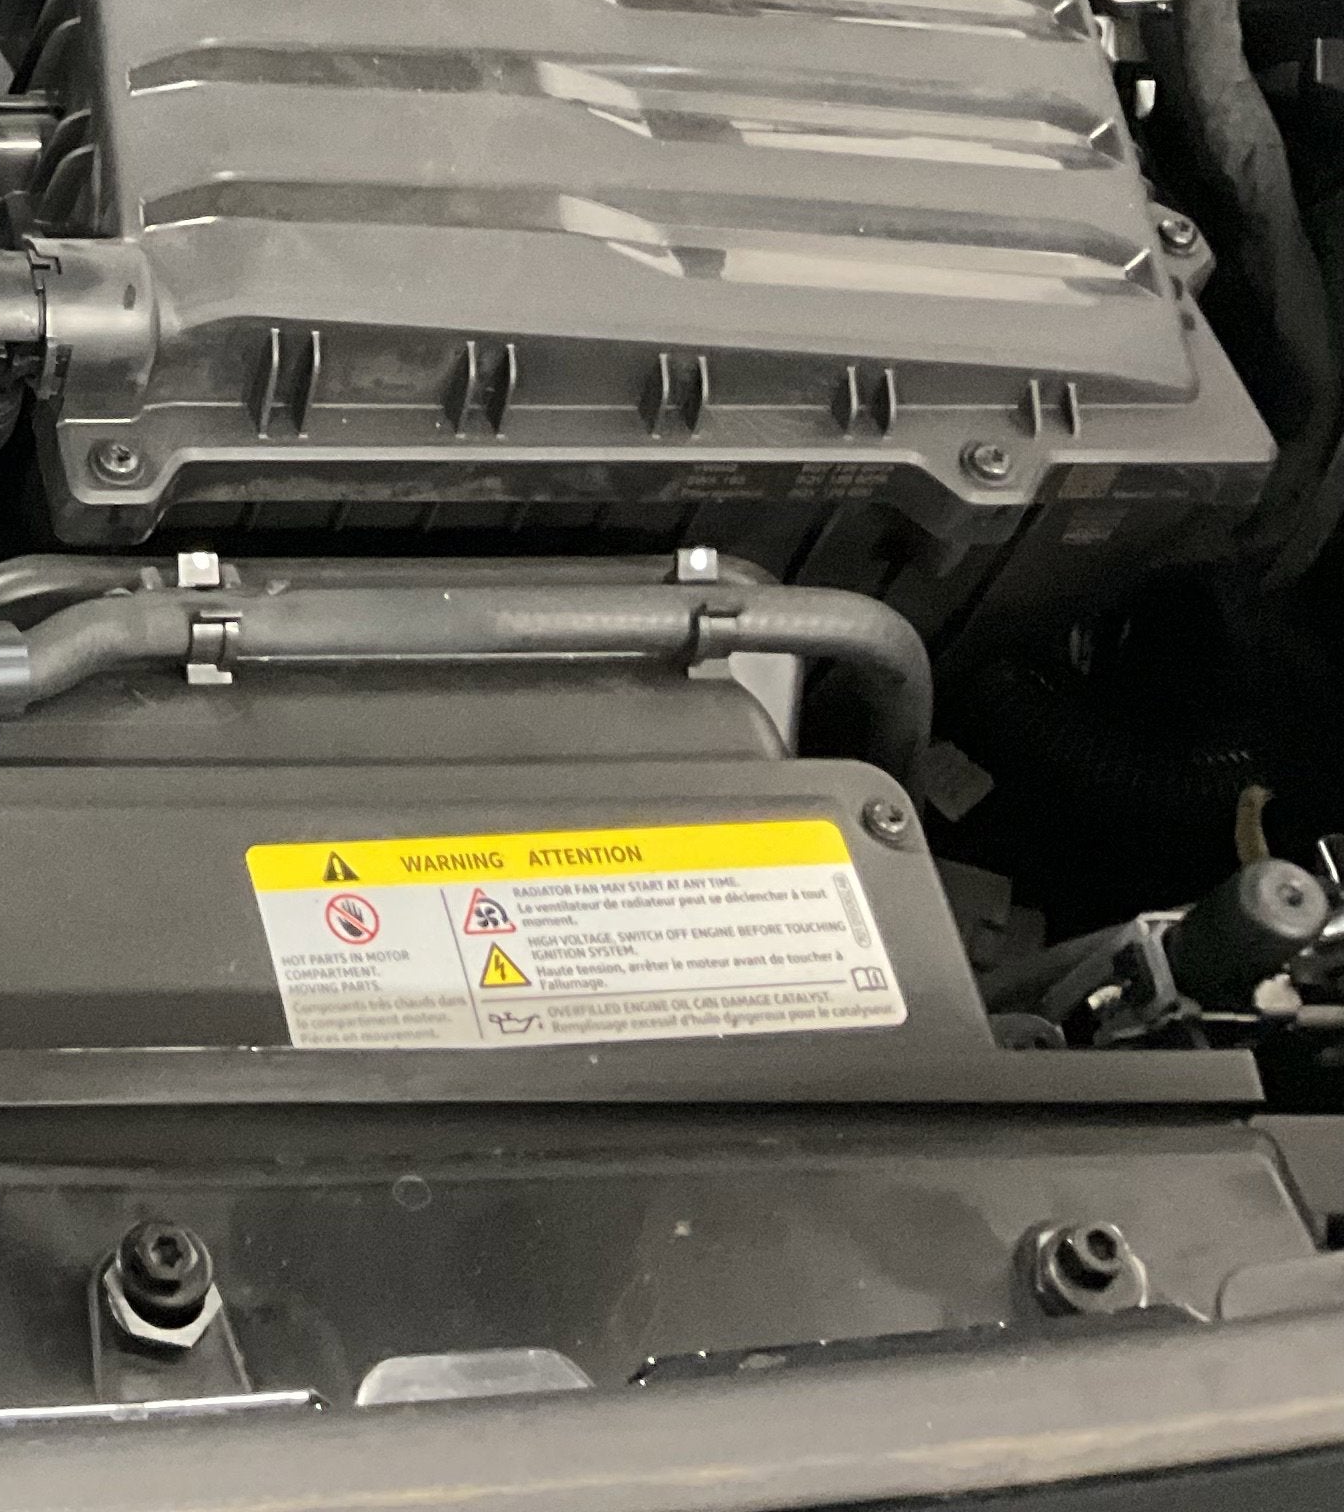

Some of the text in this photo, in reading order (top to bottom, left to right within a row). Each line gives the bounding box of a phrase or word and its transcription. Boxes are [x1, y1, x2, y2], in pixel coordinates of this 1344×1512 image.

[400, 845, 644, 874] WARNING ATTENTION
[512, 885, 573, 898] RADIATOR
[575, 883, 599, 895] FAN
[600, 882, 626, 894] MAY
[627, 879, 663, 892] START
[667, 878, 681, 889] AT
[683, 877, 706, 889] ANY
[535, 899, 601, 914] ventilateur
[603, 898, 619, 910] de
[621, 894, 676, 909] radiateur
[678, 894, 707, 909] peut
[801, 888, 828, 900] tout
[522, 915, 579, 928] moment.
[527, 935, 558, 948] HIGH
[617, 929, 663, 943] SWITCH
[666, 928, 688, 940] OFF
[691, 926, 736, 939] ENGINE
[737, 923, 784, 937] BEFORE
[785, 920, 847, 934] TOUCHING
[281, 949, 410, 967] HOT PARTS IN MOTOR
[530, 945, 639, 961] IGNITION SYSTEM.
[284, 965, 382, 981] COMPARTMENT.
[536, 965, 574, 978] Haute
[575, 963, 626, 976] tension,
[628, 959, 670, 972] arrêter
[671, 958, 684, 970] le
[686, 957, 730, 970] moteur
[732, 954, 767, 966] avant
[769, 953, 784, 965] de
[786, 950, 833, 963] toucher
[288, 981, 339, 995] MOVING
[547, 1002, 622, 1018] OVERFILLED
[623, 1000, 669, 1013] ENGINE
[671, 998, 691, 1010] OIL
[693, 996, 719, 1009] CAN
[720, 994, 771, 1008] DAMAGE
